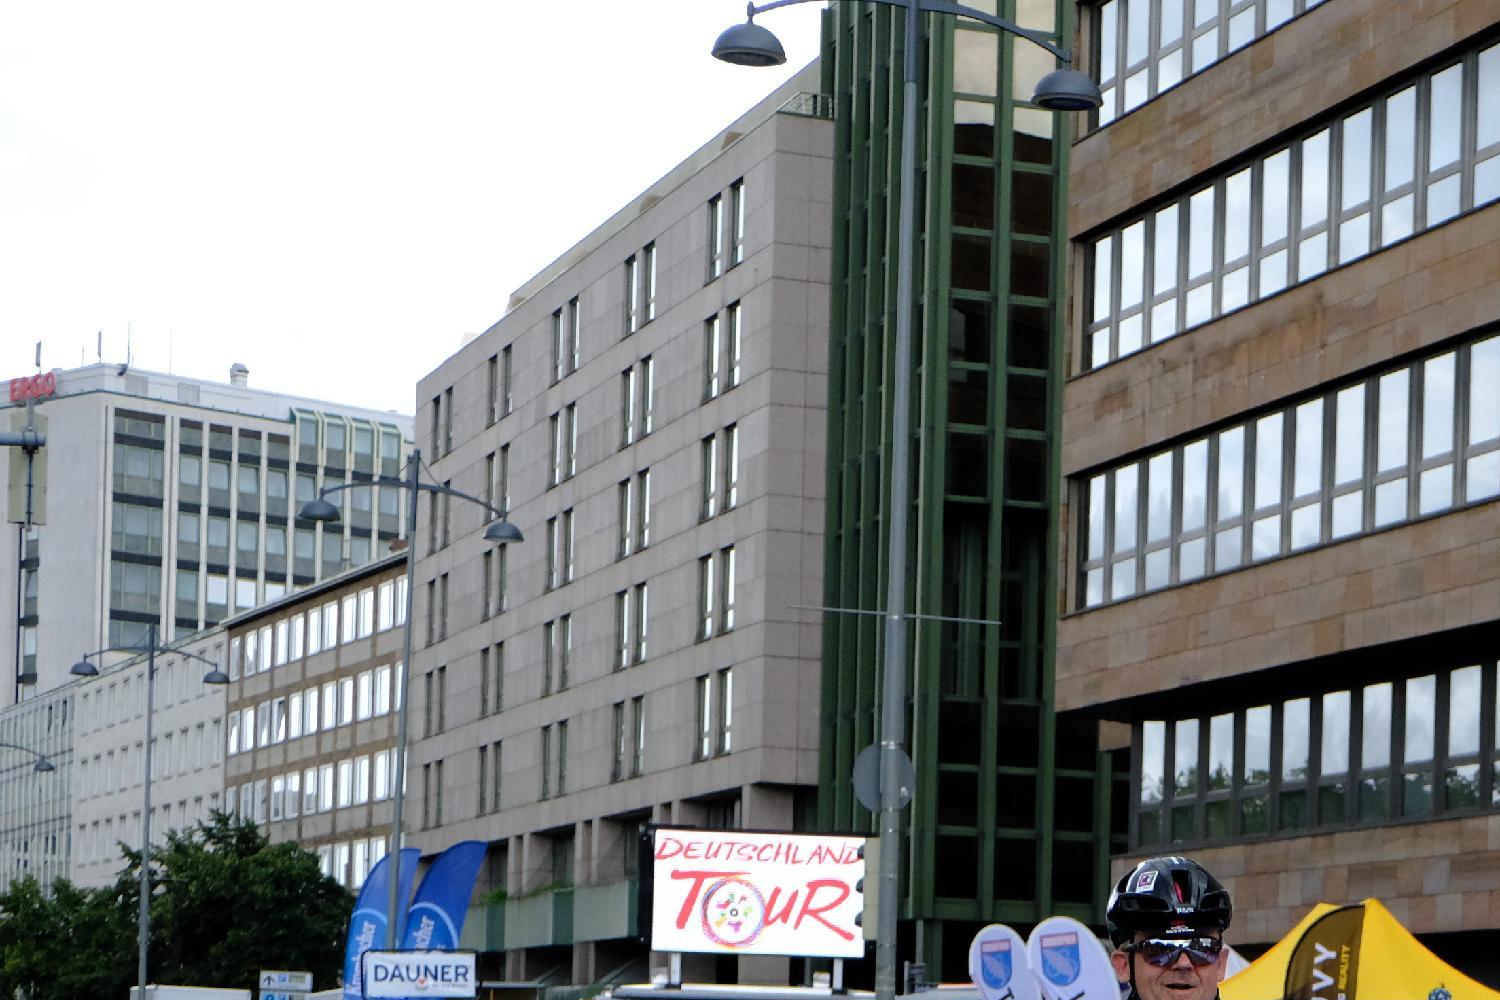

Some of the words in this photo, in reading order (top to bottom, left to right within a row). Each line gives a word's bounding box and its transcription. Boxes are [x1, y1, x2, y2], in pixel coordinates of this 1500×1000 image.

[9, 372, 56, 402] ERGO
[655, 837, 866, 866] DEUTSCHLAND
[374, 965, 469, 983] DAUNER
[1338, 945, 1350, 991] REALITY
